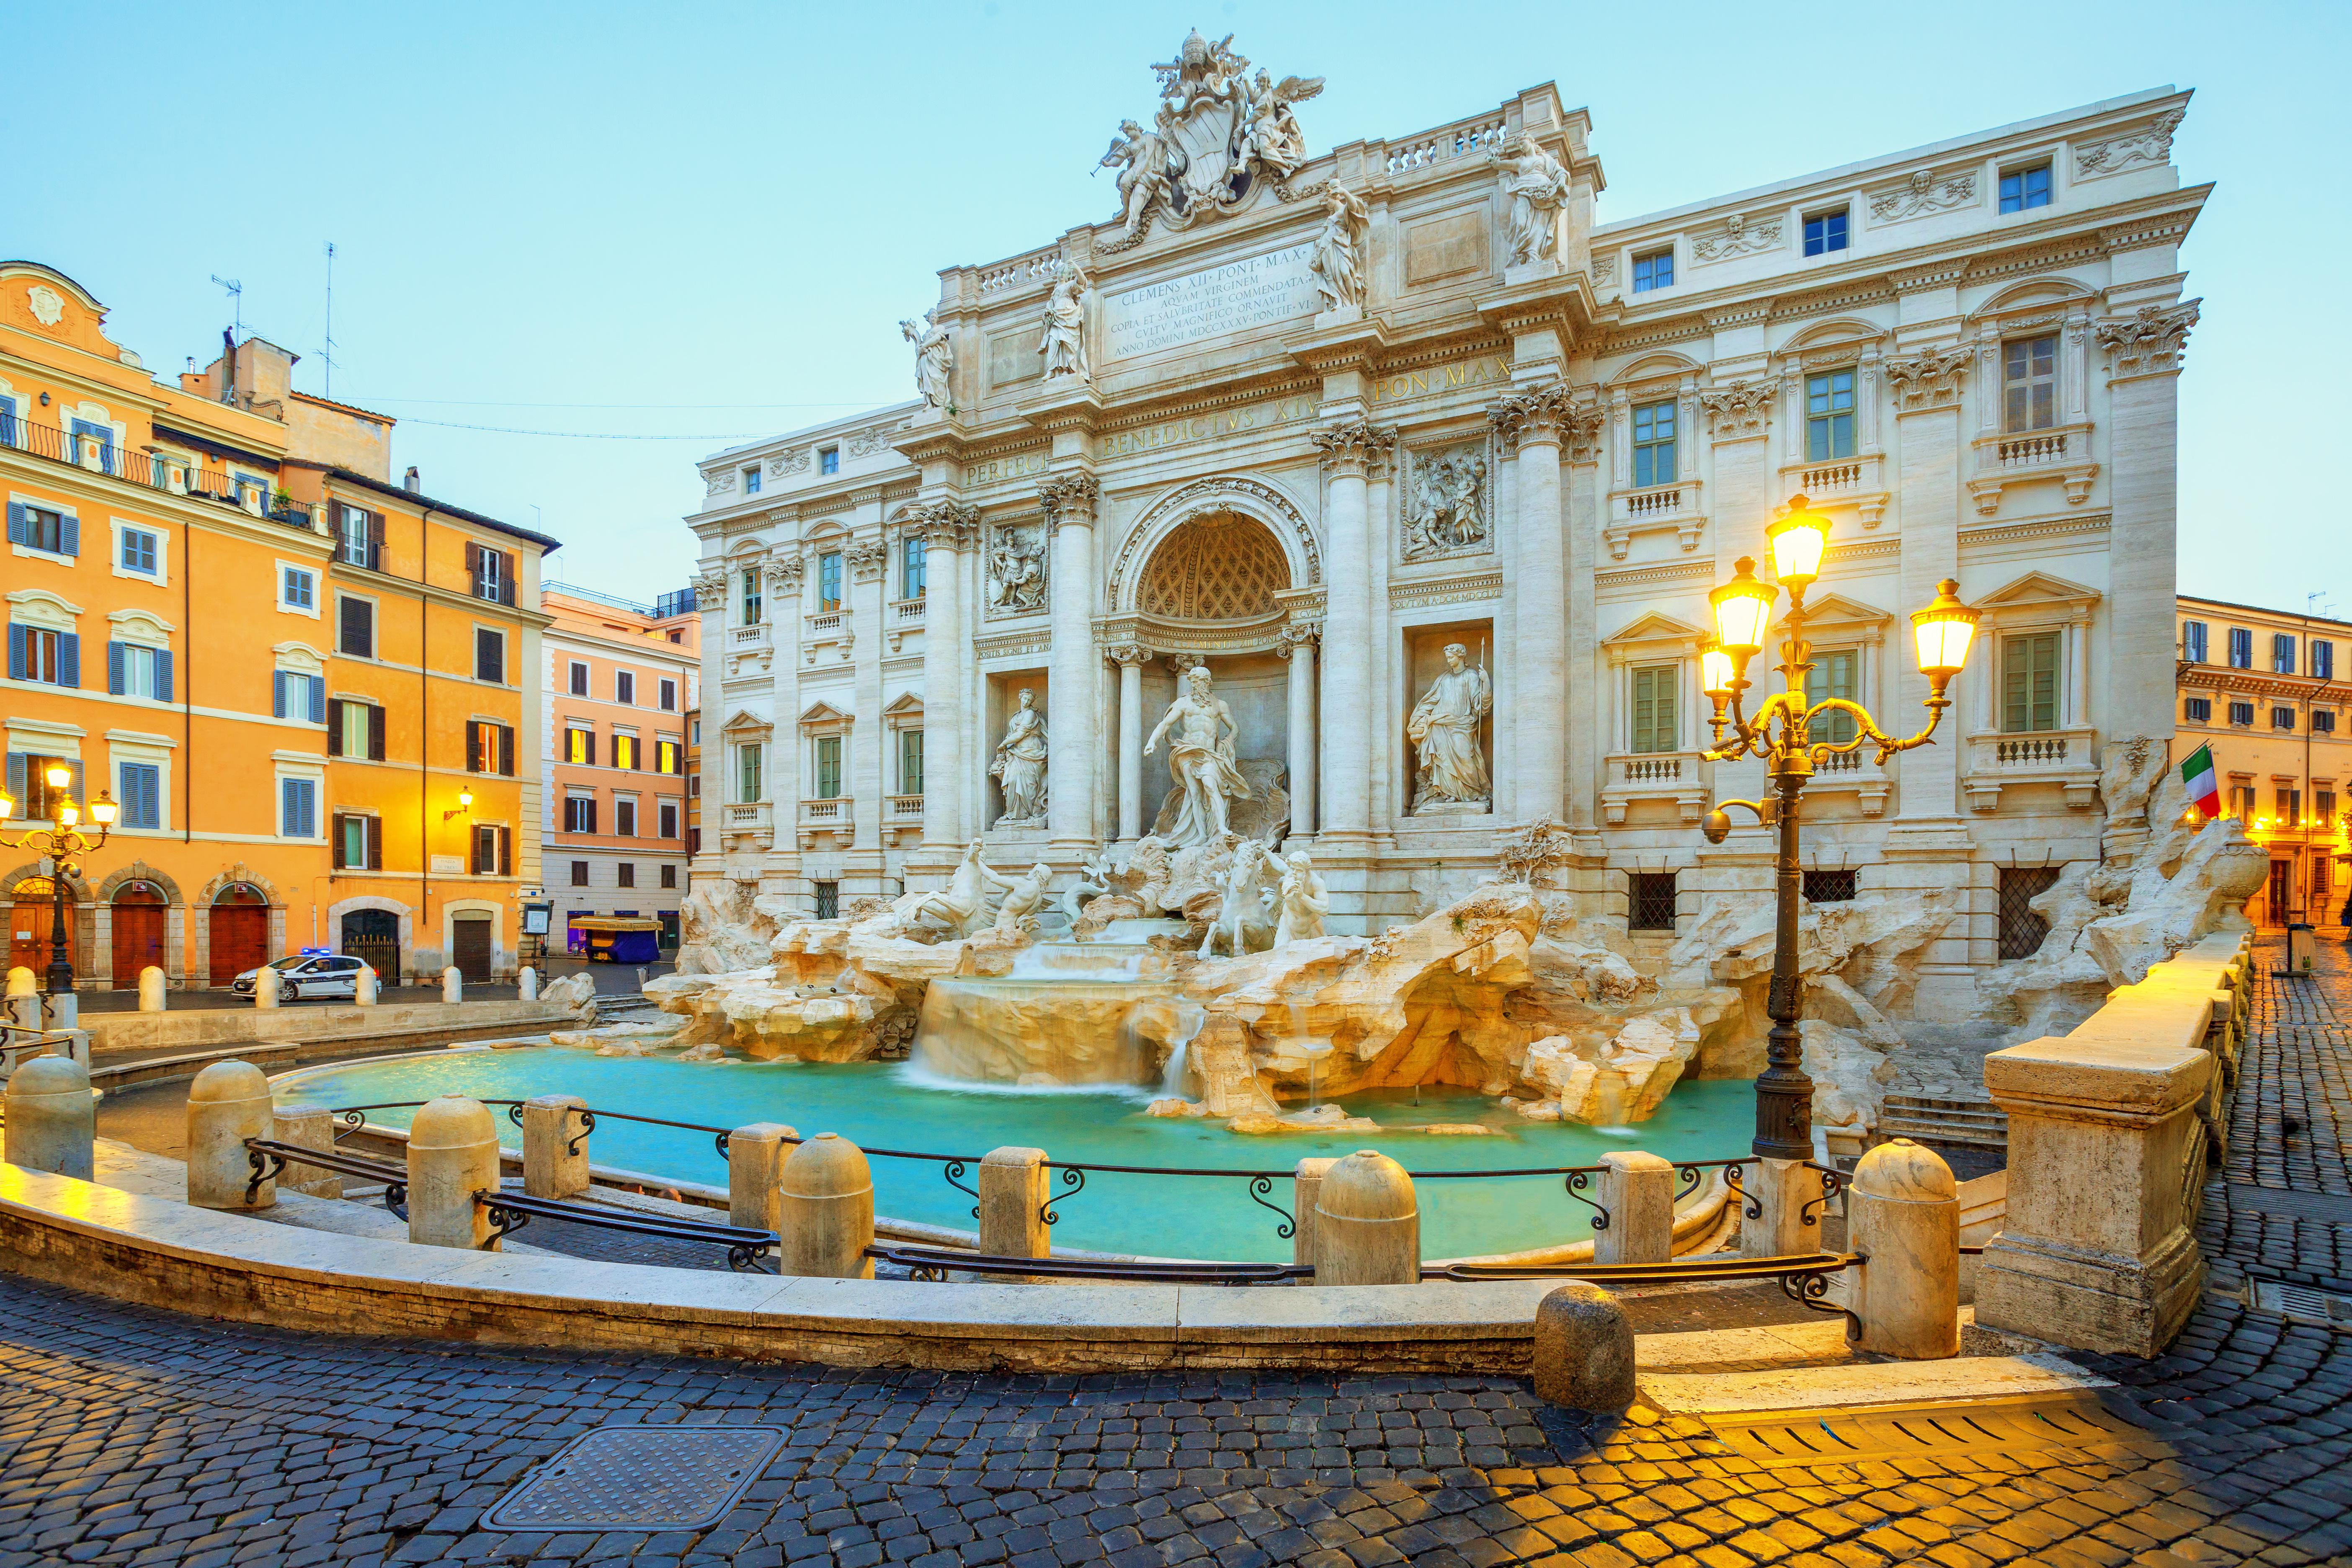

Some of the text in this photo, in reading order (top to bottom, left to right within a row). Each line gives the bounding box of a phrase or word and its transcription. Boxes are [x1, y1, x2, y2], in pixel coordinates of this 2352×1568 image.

[1122, 281, 1180, 306] CLEMENS
[1161, 275, 1258, 308] AQVAM VIRGINEM
[1111, 320, 1140, 333] COPIA
[1143, 315, 1155, 325] ET
[1158, 297, 1222, 321] SALVBRITATE
[1135, 292, 1287, 338] CVLTV MAGNIFICO ORNAVIT
[1115, 342, 1143, 356] ANNO
[1147, 332, 1184, 348] DOMINI
[966, 451, 1050, 485] PERFECI
[1103, 408, 1253, 456] BENEDICTVS
[1273, 394, 1321, 422] XIV
[1444, 355, 1511, 387] MAX
[978, 650, 1000, 658] POSITIS
[1003, 647, 1022, 655] SIGNIS
[1125, 632, 1149, 643] TABVLIS
[1153, 638, 1175, 647] IVSSV
[1391, 598, 1429, 609] SOLVTVM
